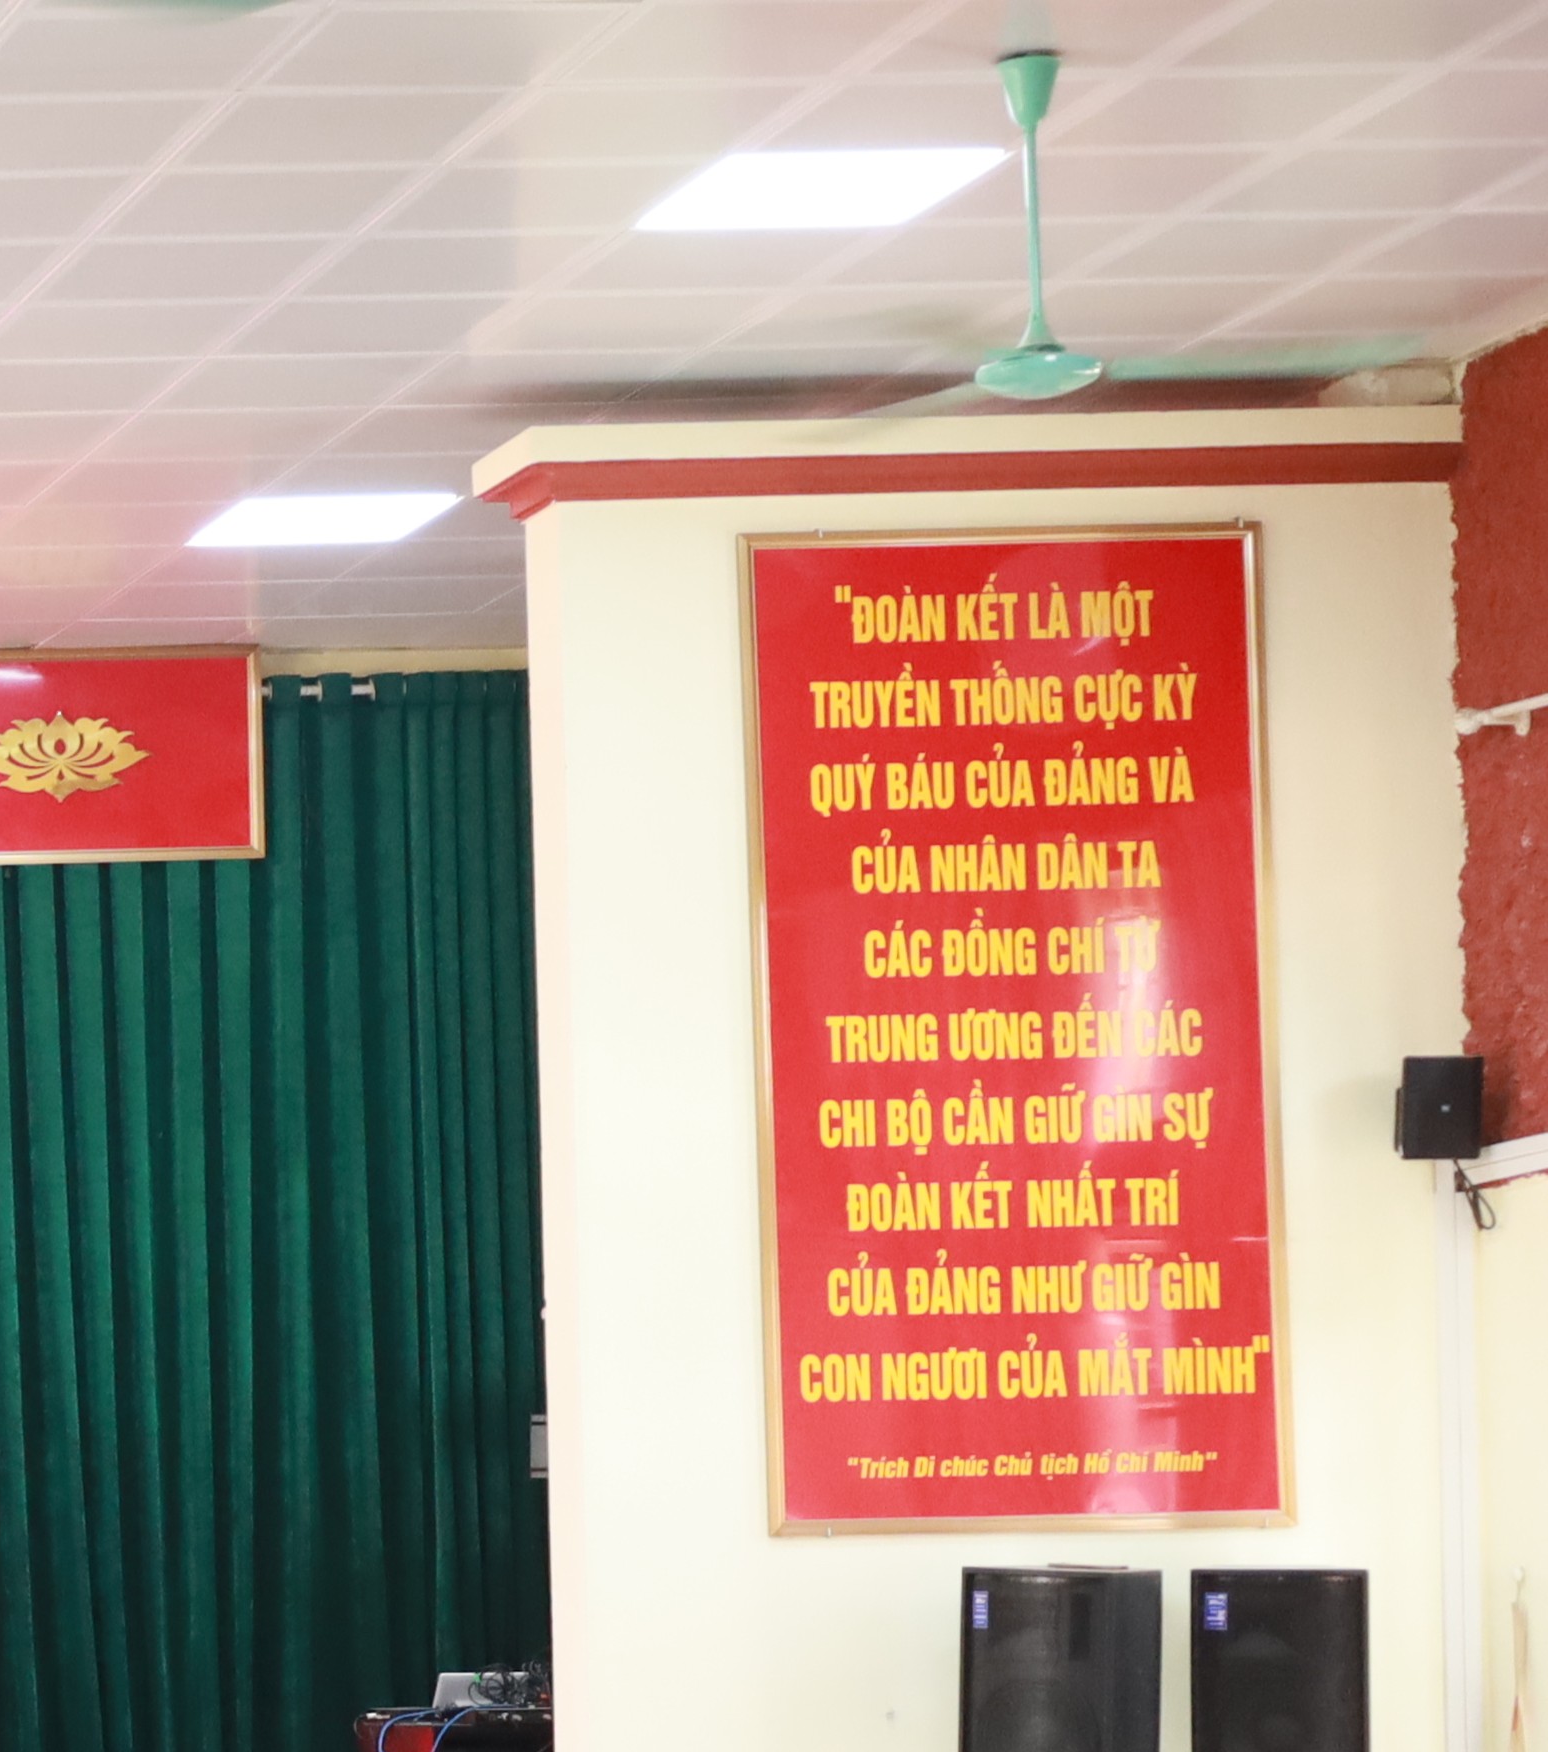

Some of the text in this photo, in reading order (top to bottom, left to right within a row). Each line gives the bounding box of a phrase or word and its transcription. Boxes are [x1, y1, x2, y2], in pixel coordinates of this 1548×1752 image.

[835, 573, 1154, 645] "ĐOÀN KẾT LÀ MỘT
[810, 661, 1198, 729] TRUYỀN THỐNG CỰC KỲ
[810, 741, 1195, 816] QUÝ BÁU CỦA ĐẢNG VÀ
[852, 829, 1162, 894] CỦA NHÂN DÂN TA
[864, 908, 1105, 978] CÁC ĐỒNG CHÍ
[825, 1008, 1044, 1063] TRUNG ƯƠNG
[819, 1080, 1086, 1155] CHI BỘ CẦN GIỮ
[846, 1161, 1180, 1232] ĐOÀN KẾT NHẤT TRÍ
[828, 1249, 1222, 1317] CỦA ĐẢNG NHƯ GÌN
[800, 1332, 1271, 1403] CON CỦA MẮT MÌNH"
[913, 1455, 935, 1478] Di
[939, 1454, 989, 1478] chúc
[994, 1451, 1034, 1477] Chủ
[1039, 1451, 1079, 1480] tịch
[1084, 1447, 1112, 1476] Hồ
[1115, 1452, 1149, 1473] Chí
